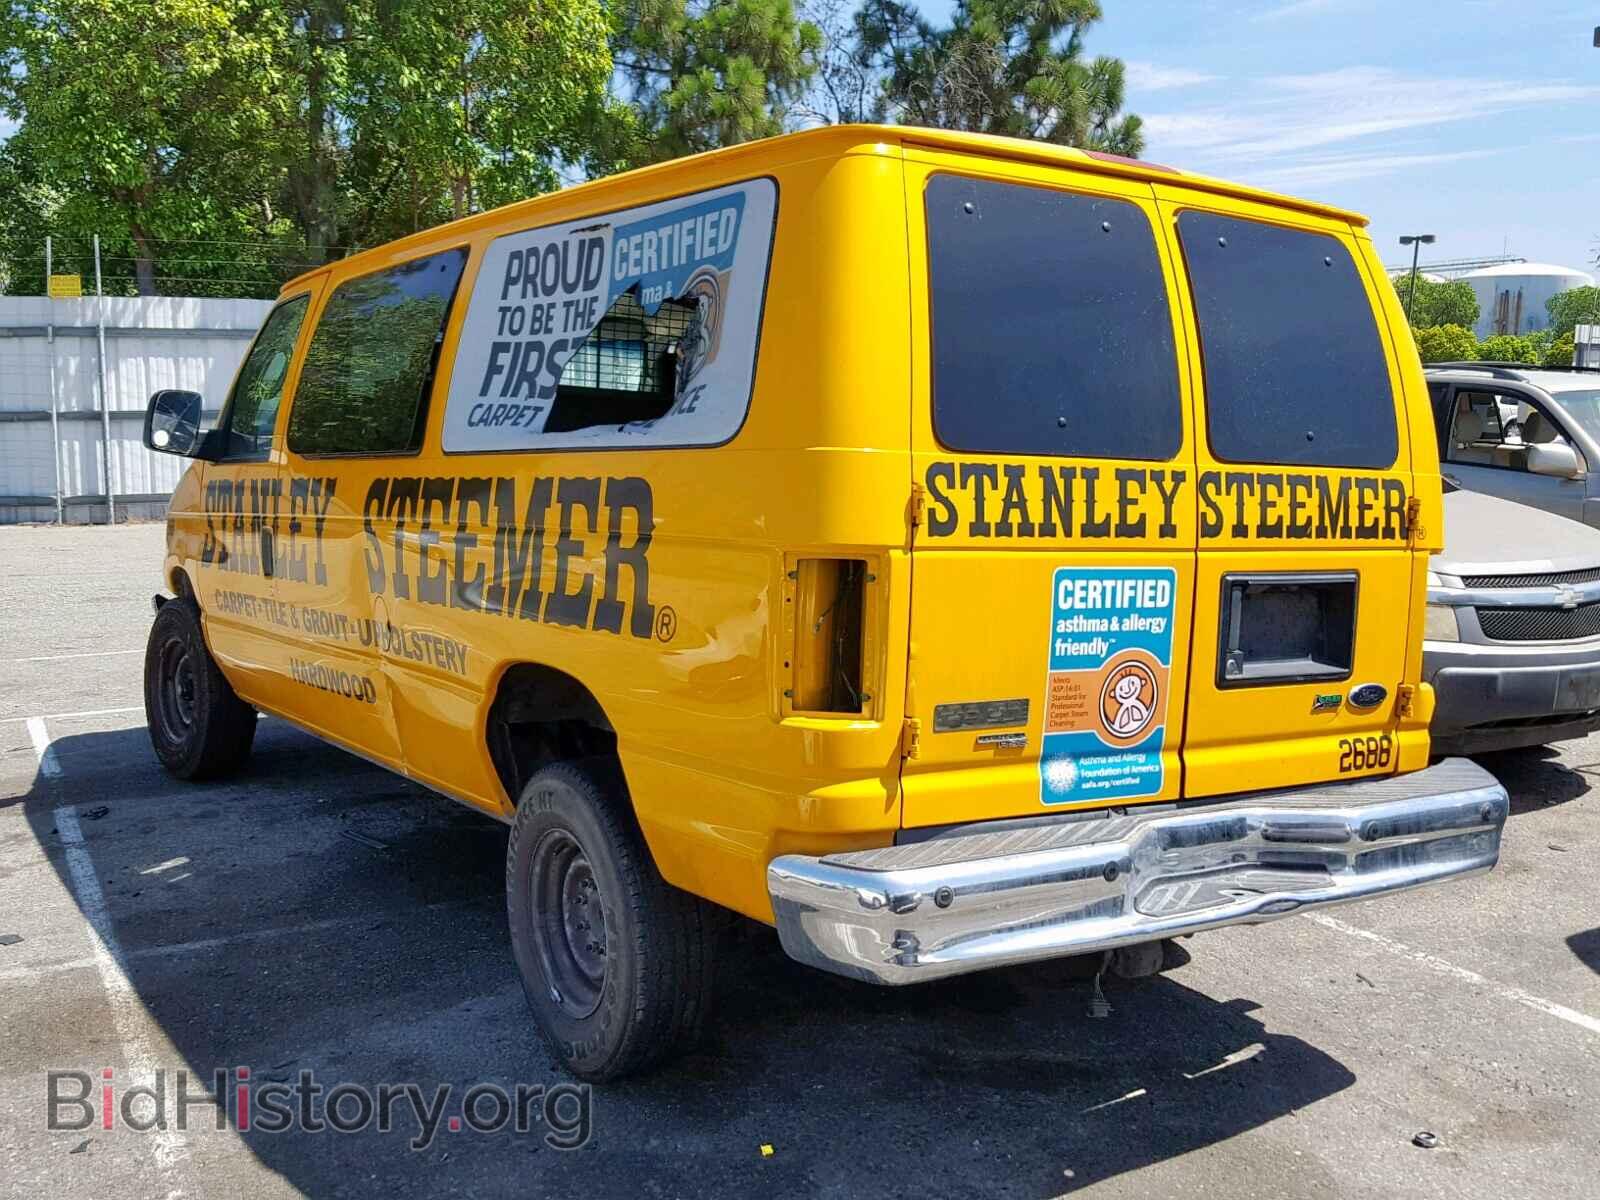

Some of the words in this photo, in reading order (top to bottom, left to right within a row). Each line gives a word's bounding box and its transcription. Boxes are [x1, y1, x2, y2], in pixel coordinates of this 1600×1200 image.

[613, 207, 738, 282] CERTIFIED
[501, 236, 605, 300] PROUD
[498, 304, 529, 336] TO
[531, 301, 554, 334] BE
[562, 296, 599, 331] THE
[467, 403, 545, 427] CARPET
[925, 461, 1187, 539] STANLEY
[201, 476, 338, 586] STANLEY
[1057, 578, 1171, 610] CERTIFIED
[1056, 614, 1108, 632] asthma
[1109, 616, 1120, 632] &
[1121, 613, 1167, 634] allergy
[289, 656, 377, 704] HARDWOOD
[1081, 767, 1122, 778] Foundation
[1131, 763, 1160, 774] America
